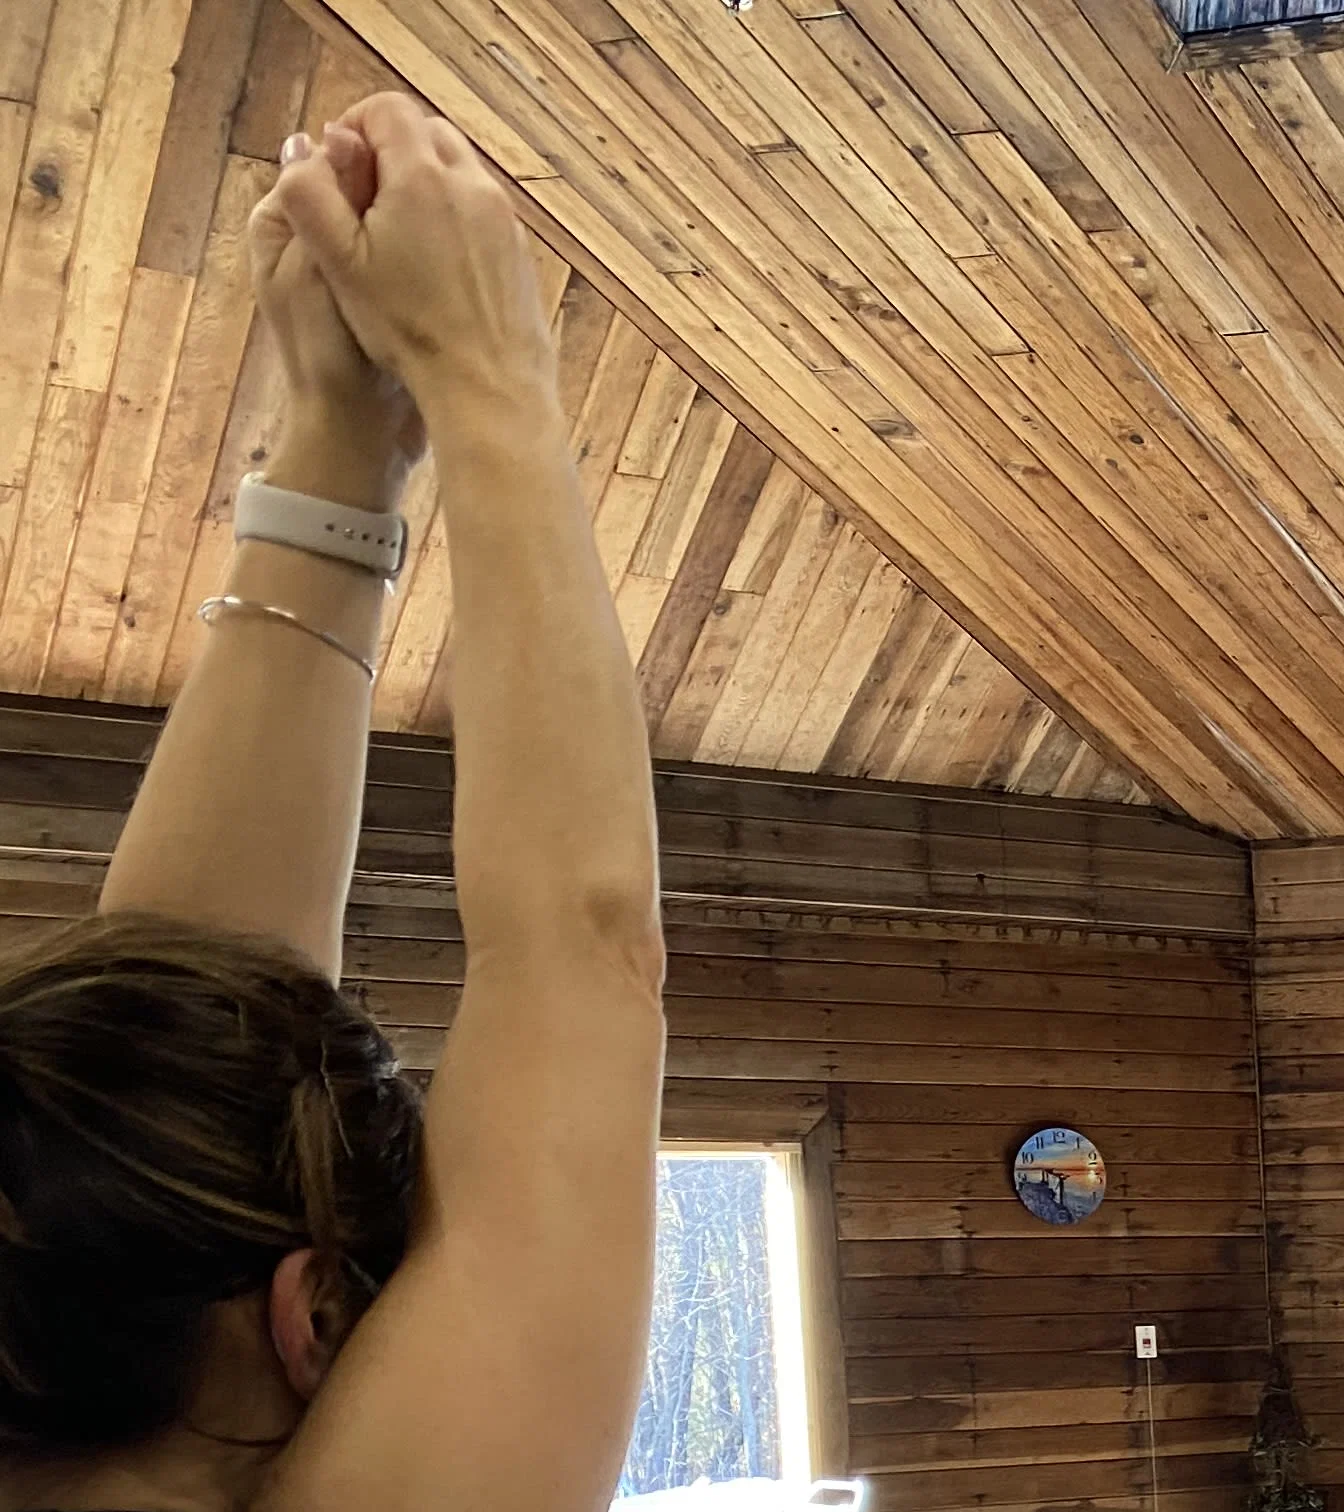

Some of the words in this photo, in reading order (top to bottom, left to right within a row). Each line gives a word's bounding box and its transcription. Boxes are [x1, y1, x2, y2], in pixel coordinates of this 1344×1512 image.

[1036, 1136, 1044, 1149] 11
[1053, 1131, 1065, 1144] 12
[1021, 1151, 1034, 1164] 10
